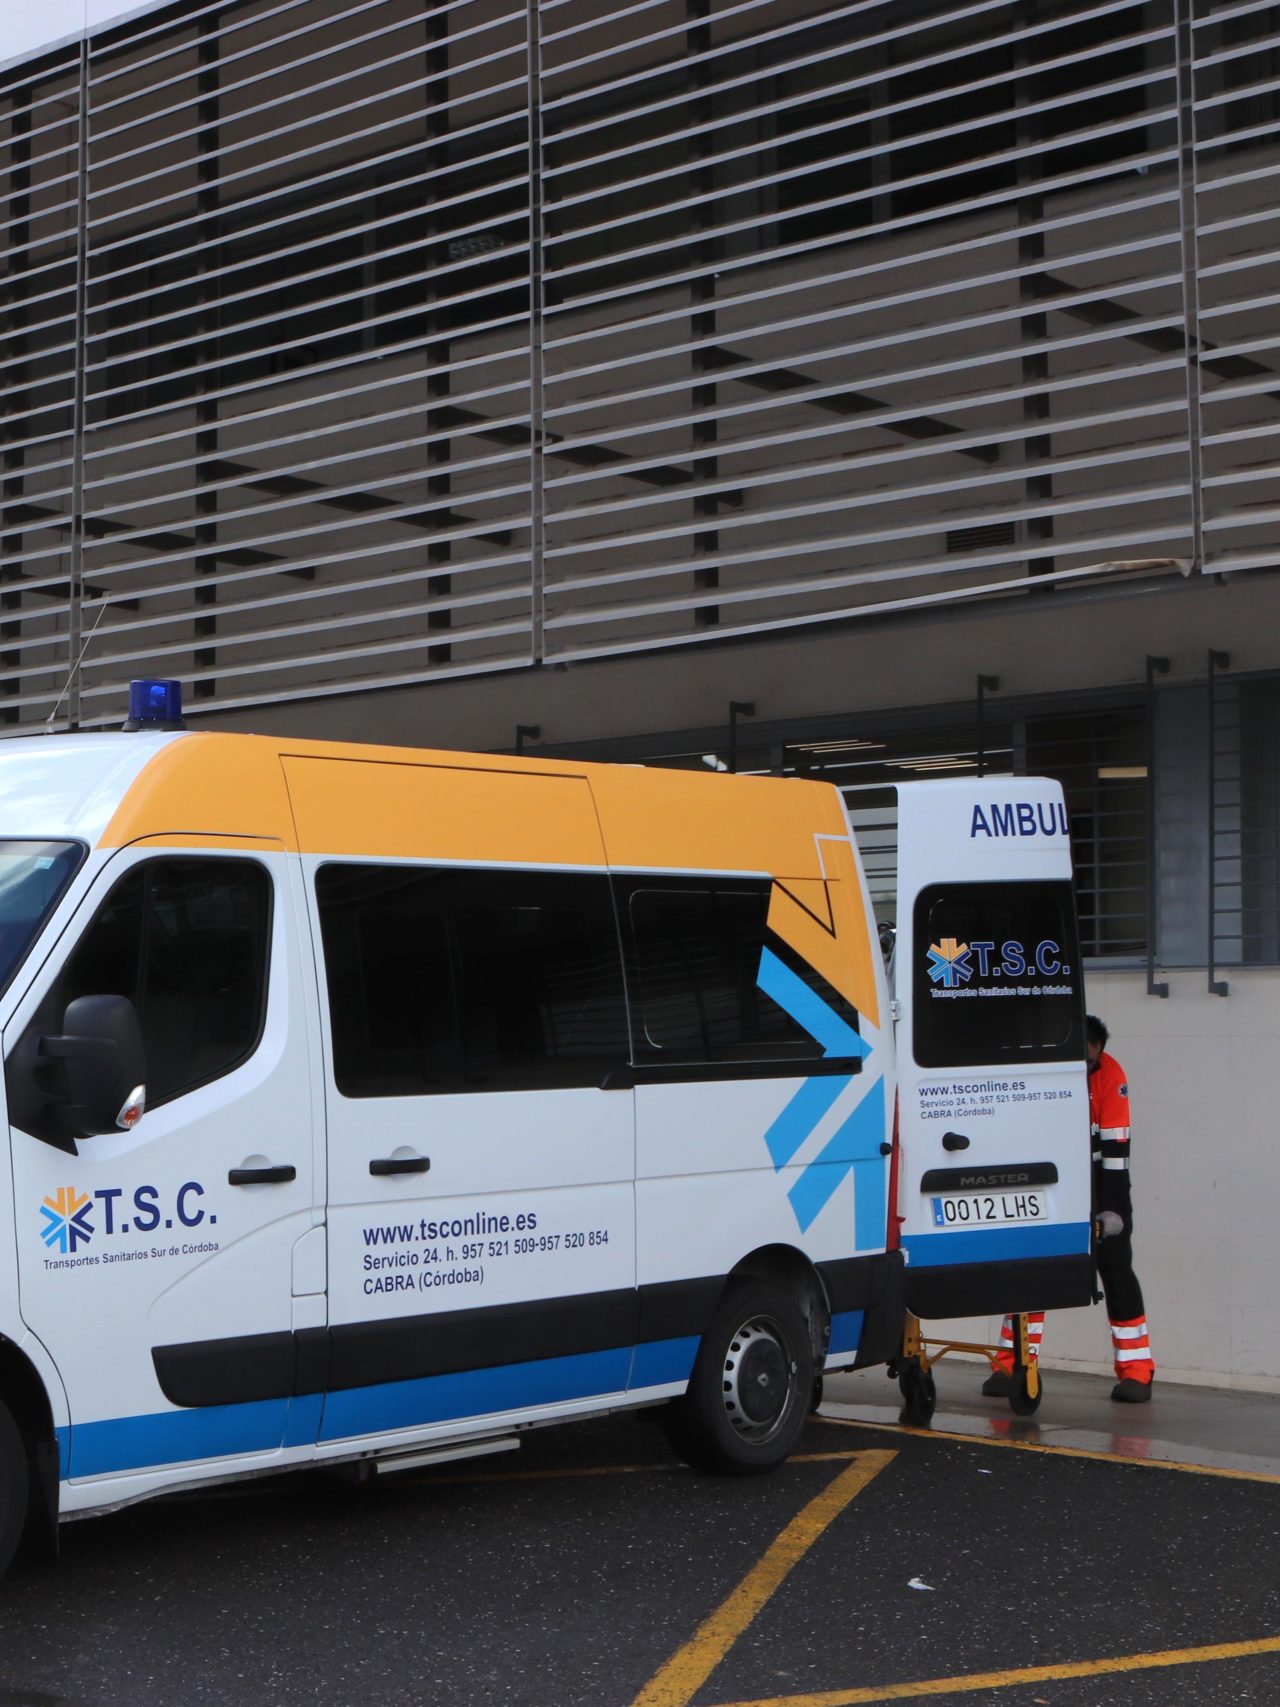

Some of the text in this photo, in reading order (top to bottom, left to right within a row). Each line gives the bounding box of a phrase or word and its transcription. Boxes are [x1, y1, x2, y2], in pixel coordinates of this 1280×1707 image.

[970, 802, 1070, 838] AMBUL
[970, 939, 1071, 977] T.S.C.
[1017, 986, 1032, 996] Sur
[918, 1080, 1026, 1097] www.tsconline.es
[919, 1090, 1073, 1108] Servicio 24. h. 957 521 509-957 520 854
[920, 1107, 995, 1120] CABRA (Córdoba)
[960, 1173, 1029, 1186] MASTER
[94, 1181, 218, 1235] T.S.C.
[944, 1197, 997, 1222] 0012
[1002, 1194, 1040, 1219] LHS
[363, 1211, 537, 1247] www.tsconline.es
[44, 1241, 219, 1271] Transportes Sanitarios Sur de Córdoba
[363, 1230, 609, 1271] Servicio 24. h. 957 521 509-957 520 854
[363, 1266, 485, 1295] CABRA (Córdoba)
